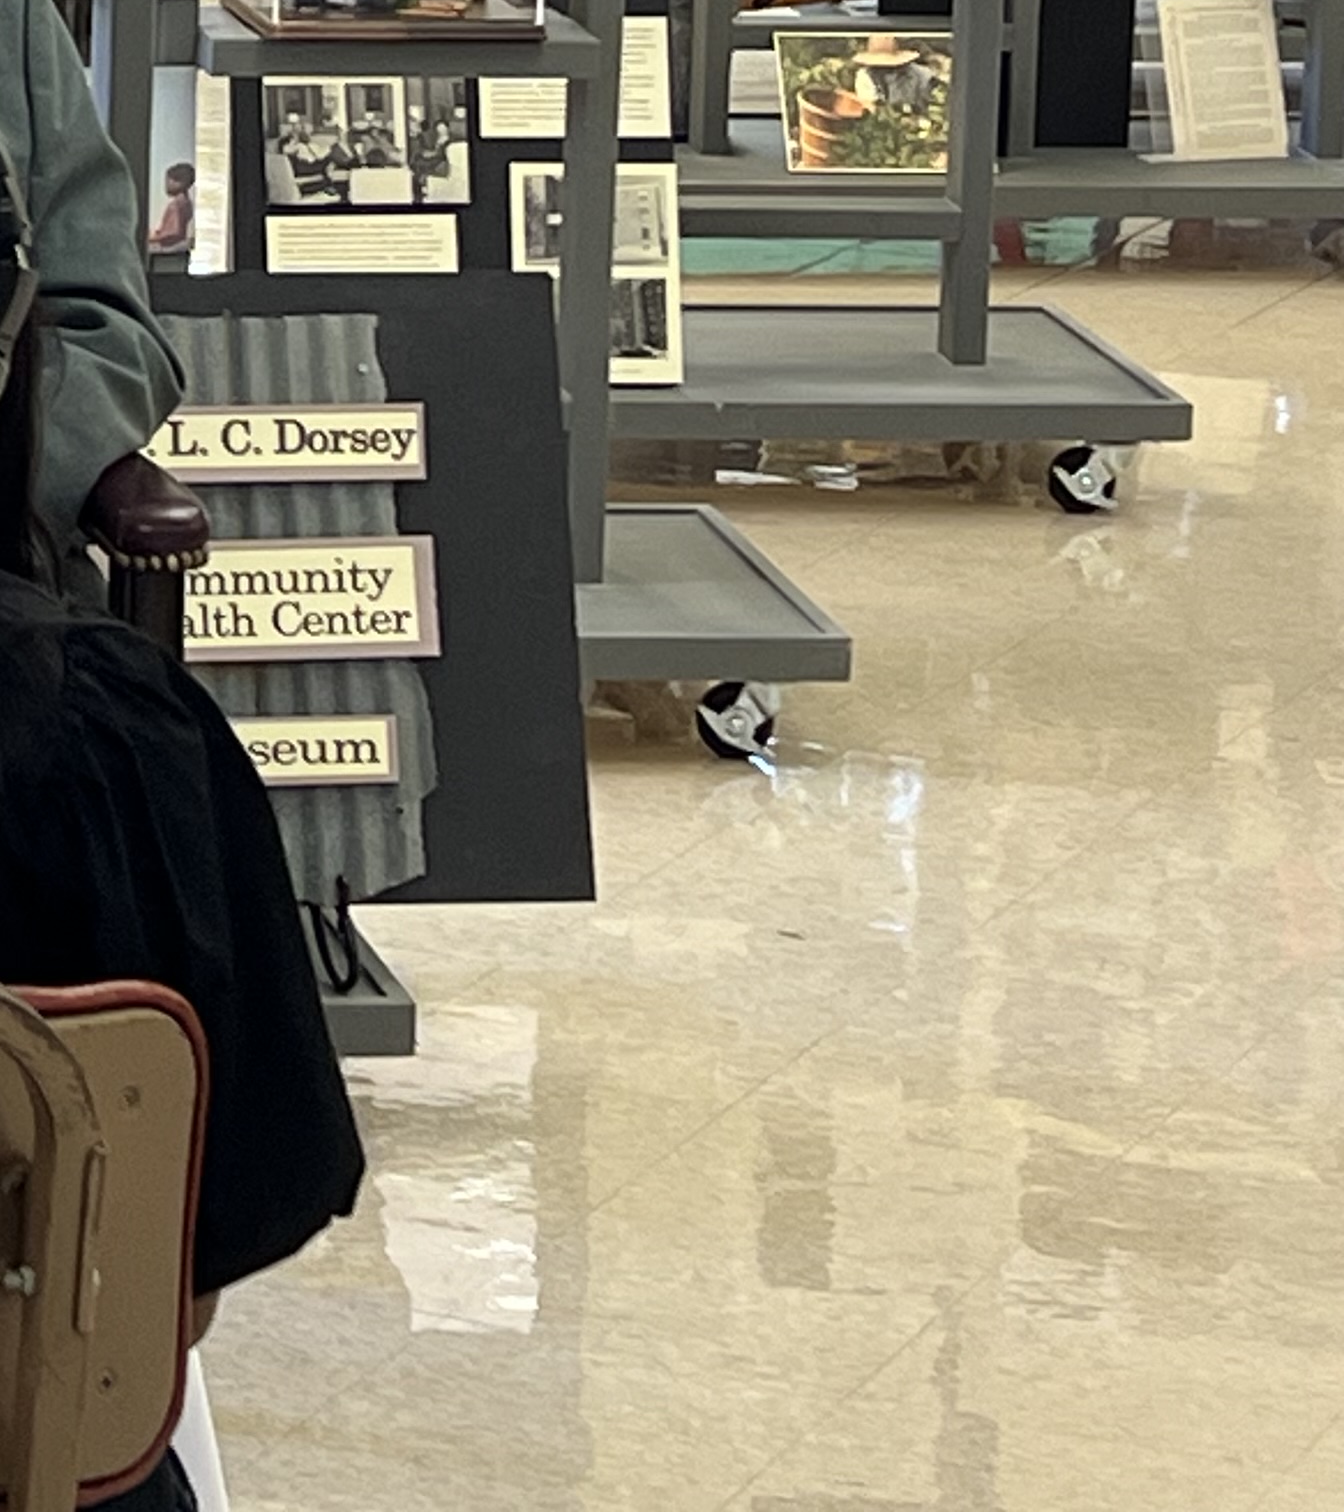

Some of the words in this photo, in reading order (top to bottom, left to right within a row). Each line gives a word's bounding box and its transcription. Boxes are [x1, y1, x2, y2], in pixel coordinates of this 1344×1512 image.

[166, 419, 210, 457] L.
[220, 418, 263, 456] C.
[273, 418, 416, 461] Dorsey
[185, 557, 393, 601] mmunity
[183, 602, 257, 639] alth
[271, 600, 413, 637] Center
[248, 735, 381, 767] seum
